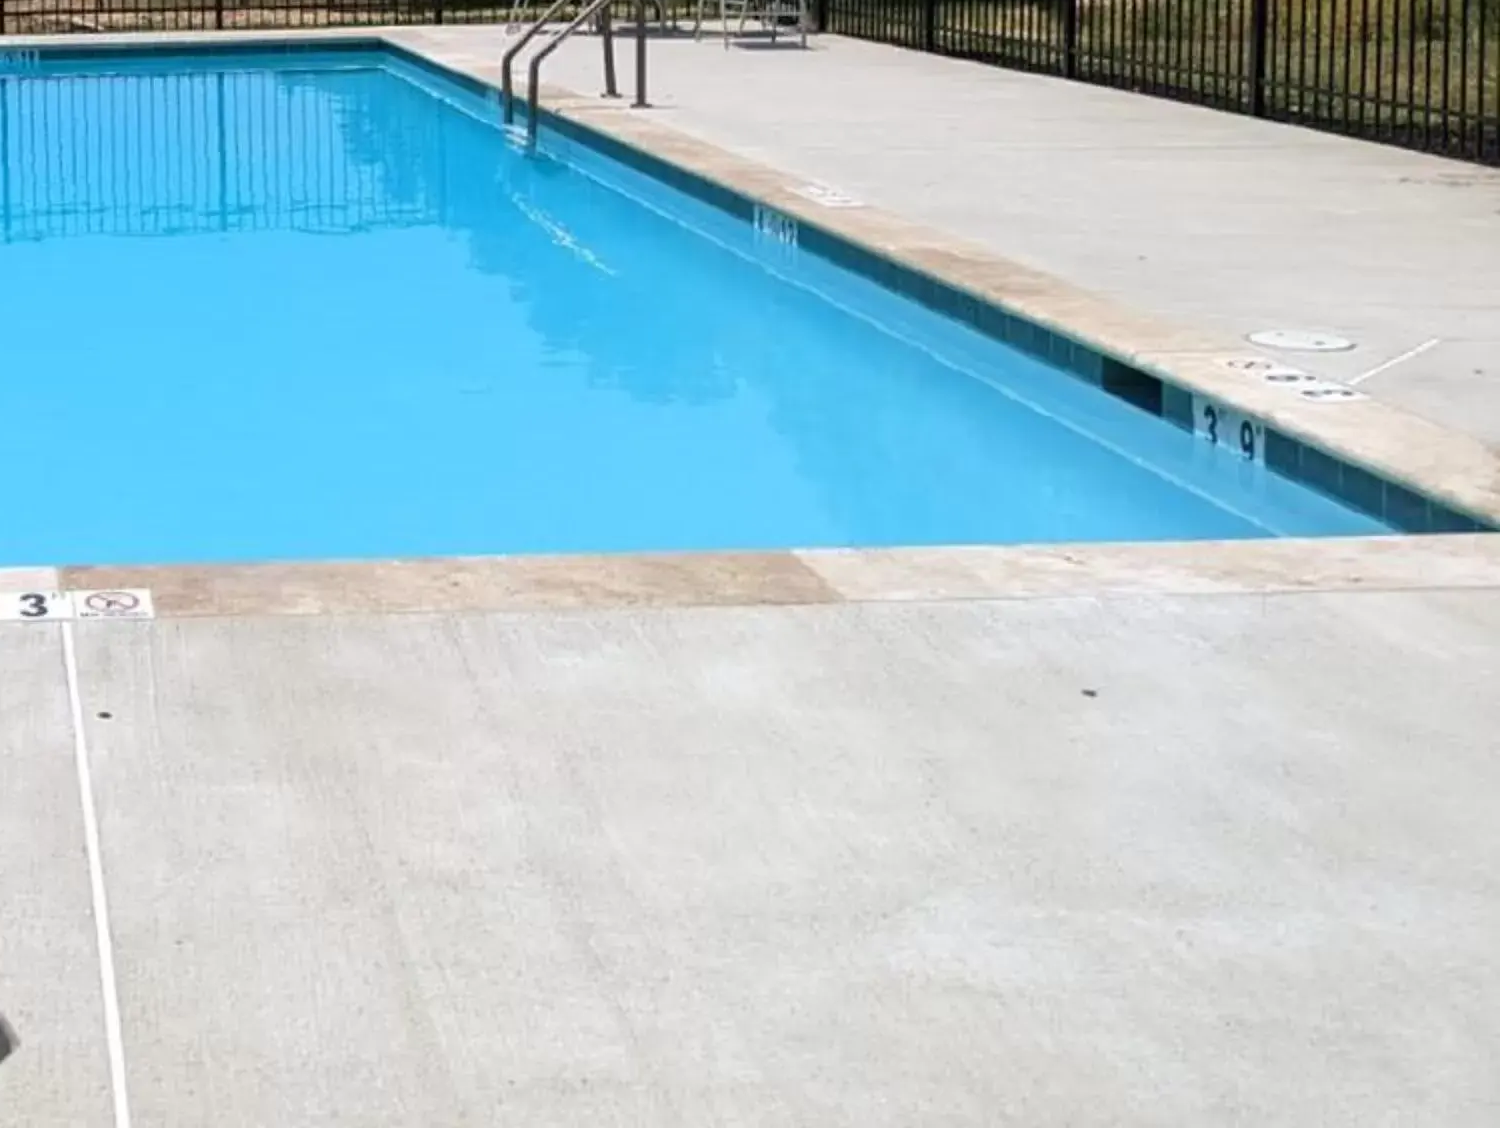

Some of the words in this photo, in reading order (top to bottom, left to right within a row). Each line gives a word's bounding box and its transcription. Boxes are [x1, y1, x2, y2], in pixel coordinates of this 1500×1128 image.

[1203, 405, 1218, 444] 3
[1240, 419, 1255, 461] 9
[18, 591, 49, 617] 3
